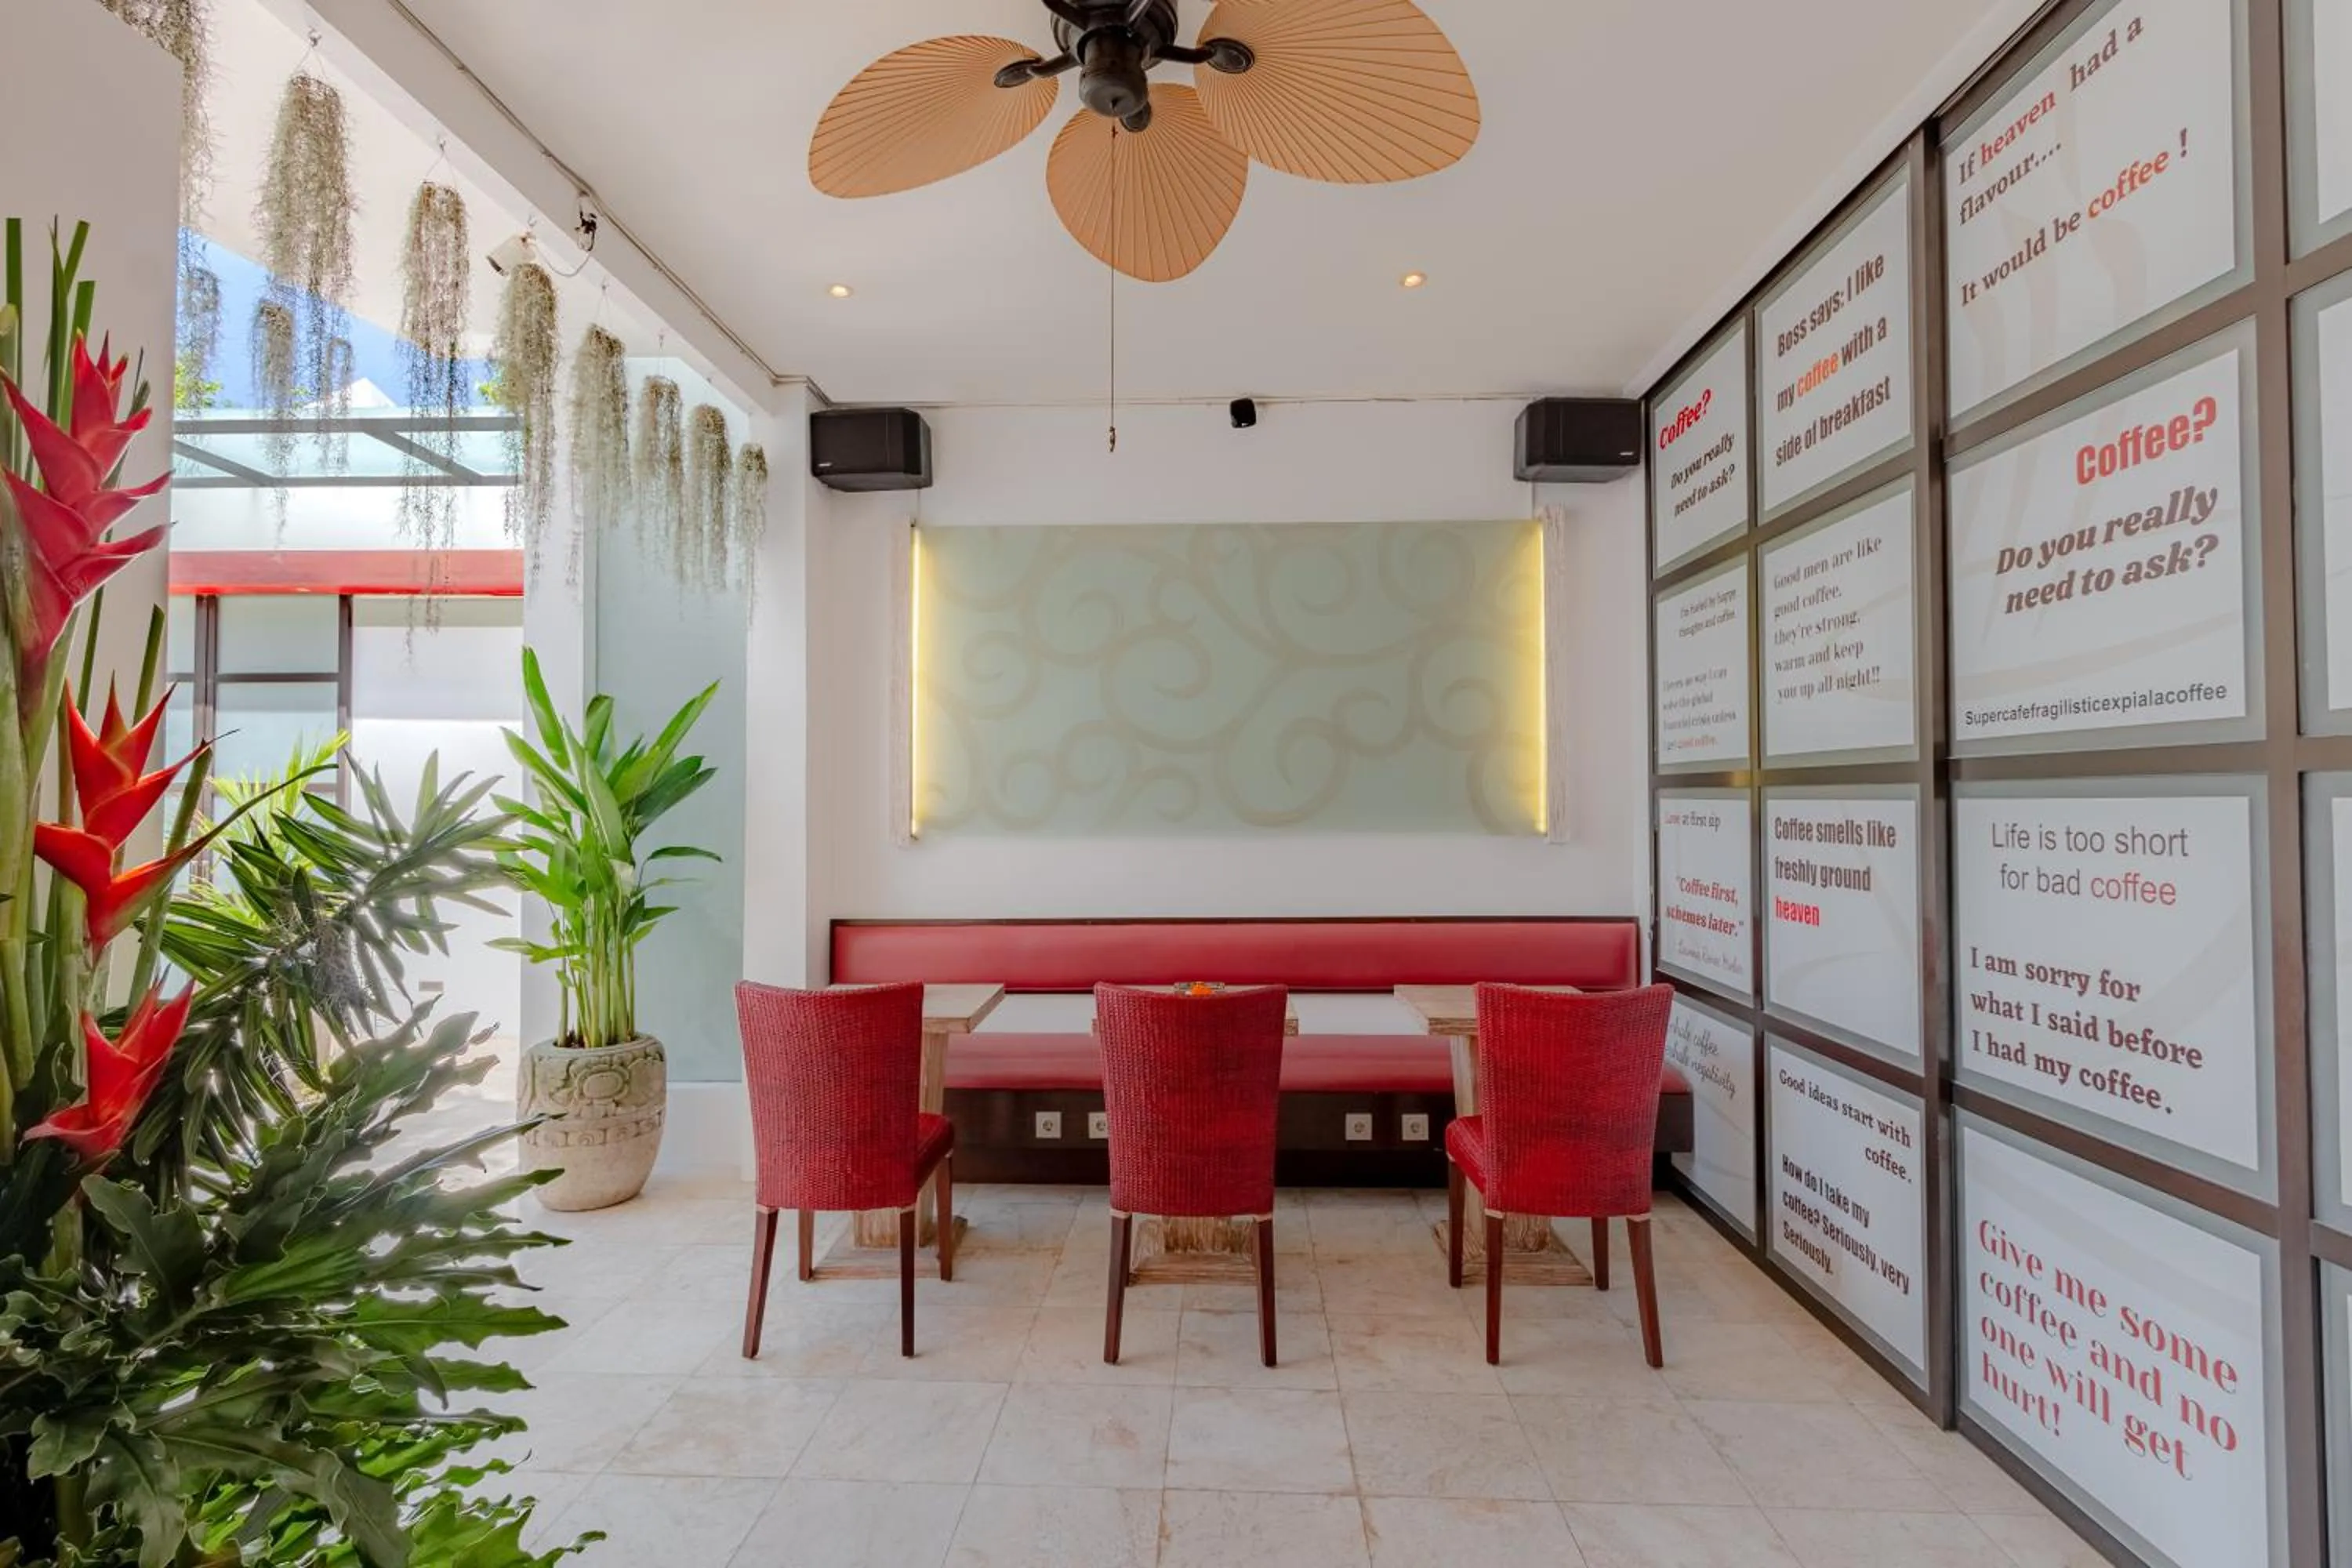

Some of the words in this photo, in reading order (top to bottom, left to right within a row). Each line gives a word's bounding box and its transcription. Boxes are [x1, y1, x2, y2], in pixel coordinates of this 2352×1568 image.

[1958, 151, 1976, 186] If
[1980, 91, 2056, 166] heaven
[2069, 29, 2119, 92] had
[2126, 16, 2143, 42] a
[1961, 282, 1977, 307] It
[1980, 227, 2046, 290] would
[2053, 211, 2082, 243] be
[2087, 150, 2170, 219] coffee
[2179, 127, 2187, 158] !
[1777, 319, 1807, 357] Boss
[1809, 290, 1844, 331] says:
[1846, 275, 1852, 302] I
[1856, 254, 1884, 295] like
[1777, 383, 1795, 412] my
[1797, 351, 1838, 397] coffee
[1841, 324, 1874, 367] with
[1876, 316, 1887, 342] a
[1659, 388, 1711, 449] Coffee?
[1776, 434, 1802, 466] side
[1804, 419, 1817, 450] of
[1819, 376, 1890, 440] breakfast
[2076, 395, 2217, 485] Coffee?
[1671, 472, 1682, 489] Do
[1683, 457, 1702, 484] you
[1703, 433, 1735, 466] really
[1674, 488, 1697, 517] need
[1697, 486, 1708, 502] to
[1708, 463, 1735, 493] ask?
[1774, 565, 1801, 590] Good
[1803, 557, 1828, 580] men
[1832, 549, 1853, 568] are
[1857, 536, 1882, 559] like
[1996, 546, 2033, 575] Do
[2037, 526, 2096, 569] you
[2103, 485, 2218, 544] really
[2005, 570, 2075, 614] need
[2081, 567, 2115, 597] to
[2122, 533, 2219, 586] ask?
[1774, 595, 1799, 622] good
[1774, 622, 1813, 645] they're
[1774, 656, 1806, 672] warm
[1808, 644, 1830, 666] and
[1834, 641, 1864, 660] keep
[1777, 687, 1797, 704] you
[1799, 682, 1814, 700] up
[1817, 674, 1833, 693] all
[1836, 664, 1880, 690] night!!
[1965, 682, 2227, 726] Supercafefragilisticexpialacoffee
[1774, 816, 1813, 841] Coffee
[1816, 819, 1864, 846] smells
[1867, 819, 1896, 848] like
[1991, 822, 2031, 849] Life
[2038, 823, 2056, 850] is
[2064, 826, 2105, 854] too
[2114, 826, 2189, 857] short
[1774, 855, 1817, 887] freshly
[1819, 865, 1871, 892] ground
[2000, 862, 2029, 891] for
[2036, 866, 2081, 895] bad
[2090, 872, 2177, 906] coffee
[1665, 903, 1707, 929] schemes
[1775, 895, 1820, 927] heaven
[1970, 946, 1980, 968] I
[1984, 953, 2018, 976] am
[2024, 962, 2091, 997] sorry
[2098, 968, 2141, 1002] for
[1969, 990, 2024, 1021] what
[2031, 1002, 2041, 1027] I
[2047, 1010, 2100, 1042] said
[2107, 1019, 2203, 1069] before
[1971, 1029, 1981, 1052] I
[1985, 1032, 2027, 1066] had
[2034, 1052, 2071, 1085] my
[2078, 1069, 2173, 1114] coffee.
[1779, 1069, 1806, 1094] Good
[1808, 1080, 1838, 1111] ideas
[1842, 1102, 1875, 1129] start
[1876, 1118, 1911, 1148] with
[1782, 1153, 1803, 1183] How
[1804, 1167, 1818, 1192] do
[1820, 1177, 1824, 1196] I
[1824, 1181, 1849, 1214] take
[1851, 1200, 1870, 1229] my
[1864, 1146, 1912, 1184] coffee.
[1782, 1190, 1820, 1226] coffee?
[1880, 1257, 1910, 1295] very
[1980, 1219, 2042, 1280] Give
[2053, 1267, 2107, 1317] me
[2119, 1305, 2238, 1395] some
[1980, 1271, 2078, 1350] coffee
[2089, 1339, 2164, 1409] and
[2180, 1393, 2238, 1452] no
[1982, 1350, 2060, 1437] hurt!
[1980, 1316, 2035, 1370] one
[2045, 1356, 2113, 1426] will
[2123, 1414, 2194, 1481] get
